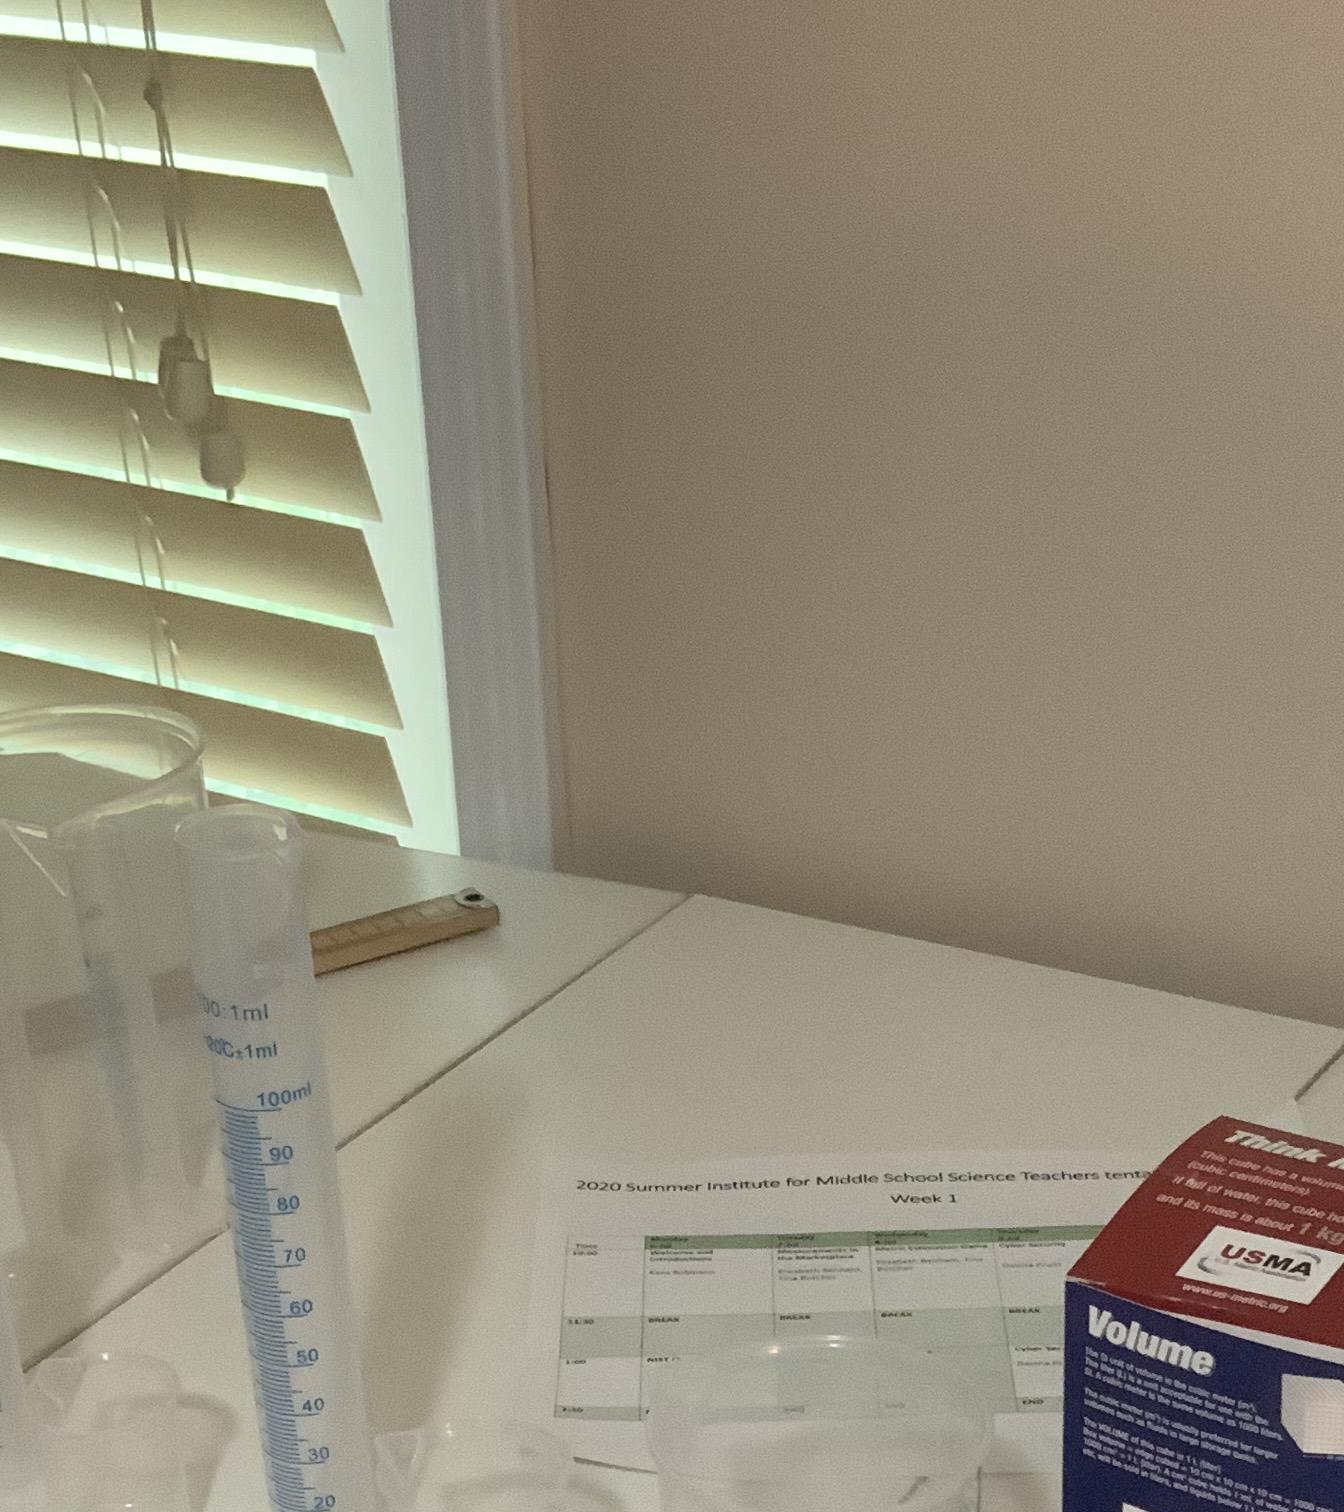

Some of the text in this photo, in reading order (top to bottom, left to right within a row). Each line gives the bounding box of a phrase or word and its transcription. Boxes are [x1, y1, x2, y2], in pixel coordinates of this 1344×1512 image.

[256, 1082, 312, 1107] 100ml
[269, 1145, 294, 1162] 90
[1224, 1129, 1327, 1164] Think
[1187, 1160, 1226, 1177] (cubic
[1199, 1150, 1227, 1164] This
[1229, 1156, 1261, 1172] cube
[1262, 1160, 1287, 1177] has
[576, 1179, 622, 1192] 2020
[625, 1180, 703, 1193] Summer
[707, 1179, 781, 1191] Institute
[786, 1176, 810, 1187] for
[816, 1172, 880, 1186] Middle
[883, 1171, 944, 1184] School
[947, 1170, 1016, 1183] Science
[1022, 1169, 1101, 1182] Teachers
[276, 1194, 301, 1212] 80
[890, 1193, 943, 1204] Week
[1156, 1192, 1181, 1206] and
[1183, 1198, 1201, 1211] its
[1201, 1203, 1240, 1220] mass
[1254, 1212, 1296, 1233] about
[1264, 1197, 1291, 1211] this
[1292, 1202, 1326, 1219] cube
[283, 1247, 307, 1263] 70
[1219, 1243, 1313, 1278] USMA
[289, 1299, 313, 1316] 60
[1087, 1303, 1217, 1377] Volume
[296, 1348, 319, 1364] 50
[302, 1397, 325, 1413] 40
[308, 1446, 331, 1463] 30
[314, 1495, 337, 1512] 20
